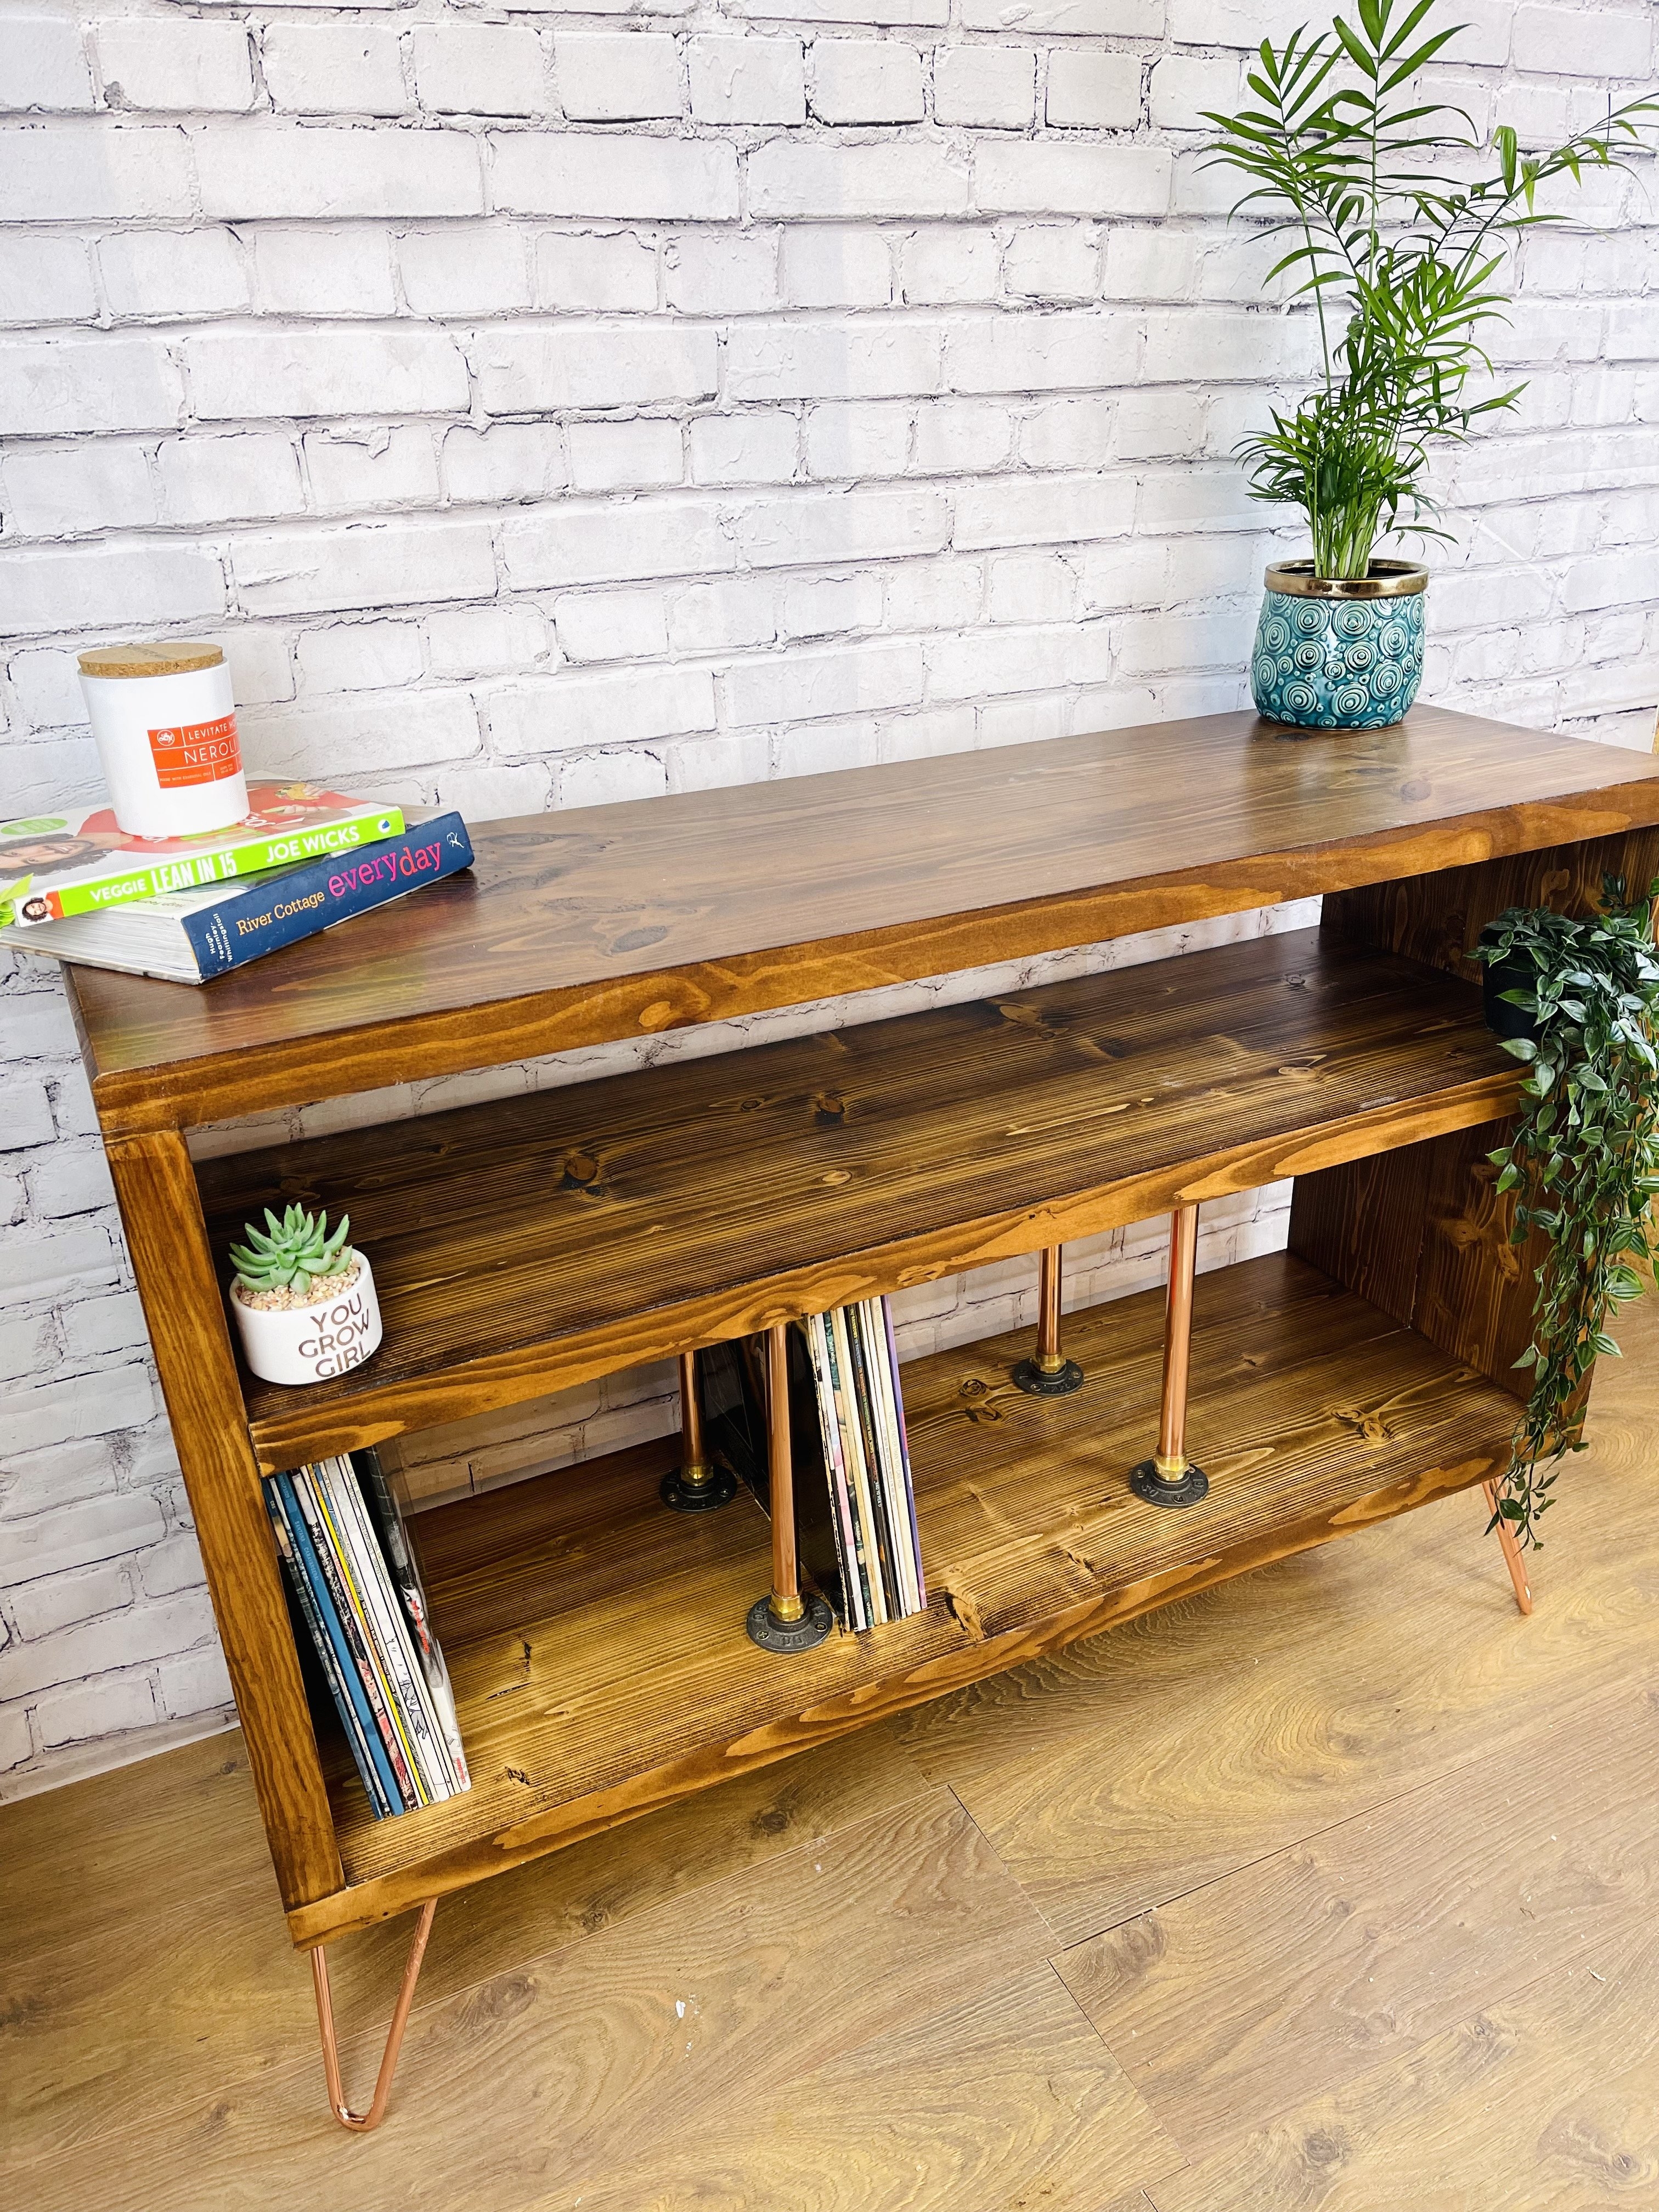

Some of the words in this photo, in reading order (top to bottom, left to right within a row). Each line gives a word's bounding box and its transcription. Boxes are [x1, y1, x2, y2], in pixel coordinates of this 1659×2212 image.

[188, 723, 227, 740] LEVITATE
[184, 738, 236, 764] NEROLI
[89, 878, 147, 902] VEGGIE
[151, 862, 195, 894] LEAN
[196, 857, 217, 882] IN
[219, 851, 238, 878] 15
[266, 839, 301, 862] JOE
[302, 826, 360, 853] WICKS
[235, 912, 273, 935] River
[274, 891, 325, 919] Cottage
[328, 842, 441, 898] everyday
[205, 933, 216, 955] Hugh
[212, 913, 233, 962] Whittingstall
[310, 1293, 362, 1333] YOU
[873, 1304, 882, 1330] NATHANIEL
[298, 1308, 369, 1358] GROW
[315, 1341, 371, 1378] GIRL
[294, 1520, 306, 1545] SANTANA
[303, 1547, 320, 1582] CARAVANSERAI
[375, 1551, 385, 1564] SIMON
[380, 1565, 393, 1588] GRACELAND
[381, 1660, 389, 1675] TOTALLY
